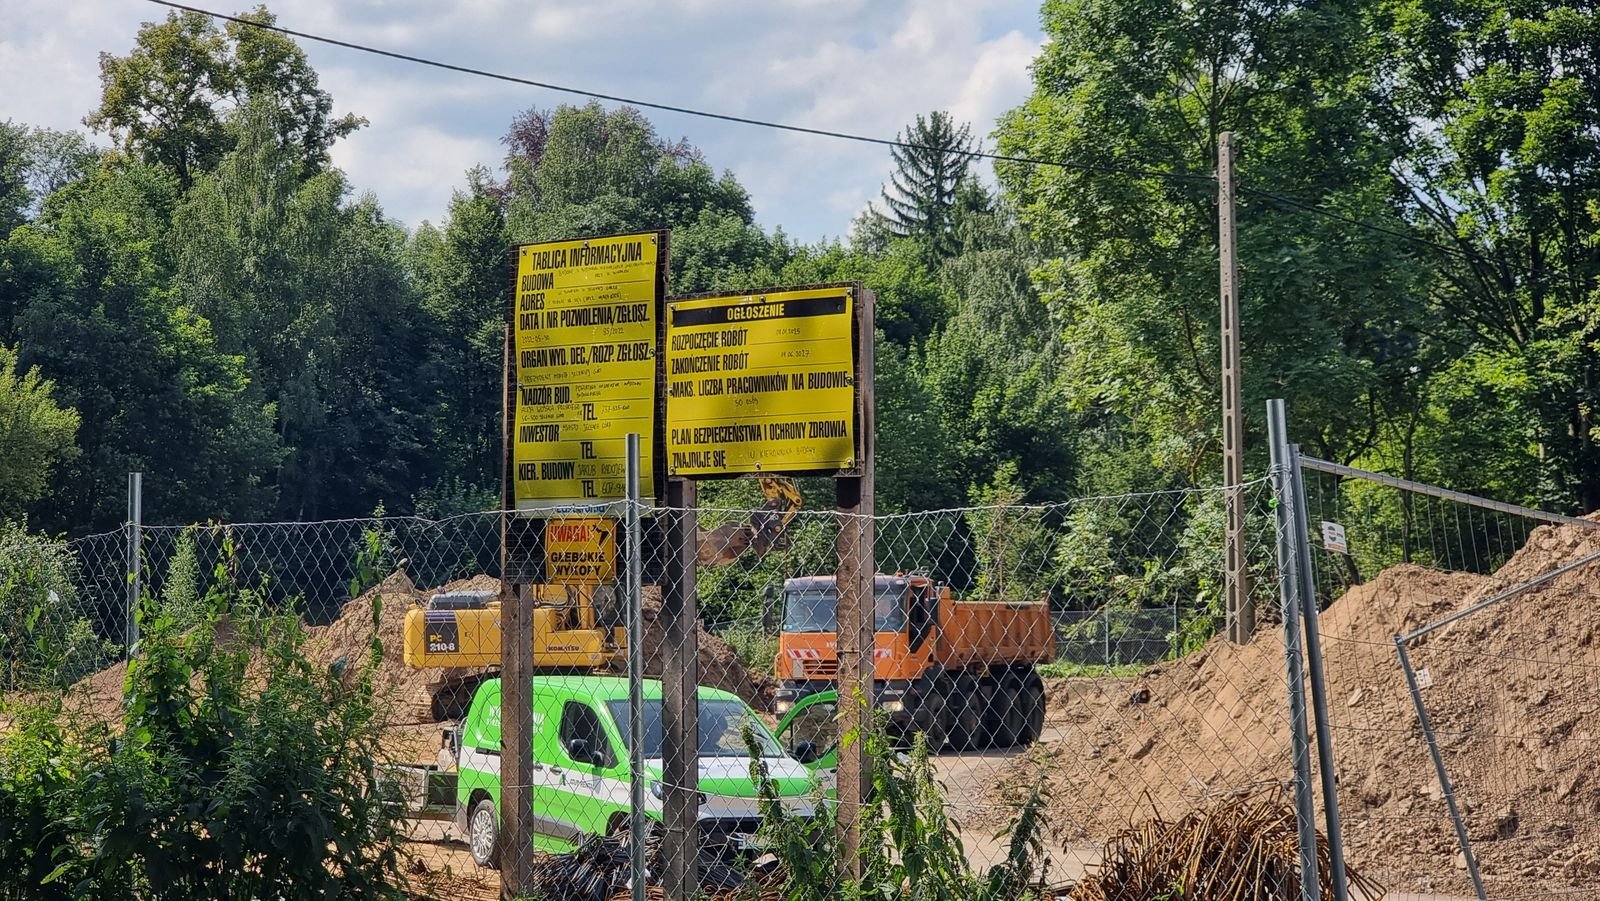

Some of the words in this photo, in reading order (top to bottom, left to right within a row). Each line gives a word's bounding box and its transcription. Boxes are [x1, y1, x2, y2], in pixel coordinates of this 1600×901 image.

[532, 249, 566, 271] TABLICA
[570, 241, 642, 267] INFORMACYJNA
[521, 272, 554, 292] BUDOWA
[520, 293, 545, 311] ADRES
[727, 303, 785, 321] OGŁOSZENIE
[520, 313, 539, 331] DATA
[541, 313, 545, 329] I
[546, 312, 558, 328] NR
[671, 331, 720, 351] ROZPOCZĘCIE
[721, 328, 748, 348] ROBÓT
[521, 349, 548, 369] ORGAN
[549, 348, 569, 367] WYD.
[617, 342, 651, 362] ZGŁOSZ.
[671, 353, 720, 375] ZAKOŃCZENIE
[722, 351, 749, 371] ROBÓT
[672, 380, 696, 398] MAKS.
[698, 378, 724, 397] LICZBA
[726, 371, 789, 395] PRACOWNIKÓW
[791, 374, 804, 390] NA
[808, 370, 848, 389] BUDOWIE
[521, 385, 552, 406] NADZÓR
[554, 385, 573, 405] BUD.
[582, 403, 598, 421] TEL.
[519, 424, 560, 443] INWESTOR
[671, 427, 692, 445] PLAN
[694, 422, 762, 444] BEZPIECZEŃSTWA
[764, 424, 768, 441] I
[769, 422, 807, 440] OCHRONY
[808, 420, 848, 438] ZDROWIA
[672, 452, 712, 469] ZNAJDUJE
[713, 450, 727, 470] SIĘ
[518, 463, 539, 481] KIER.
[541, 461, 575, 481] BUDOWY
[550, 525, 590, 542] UWAGA!
[556, 565, 601, 576] WYKOPY
[430, 642, 455, 651] 210-8
